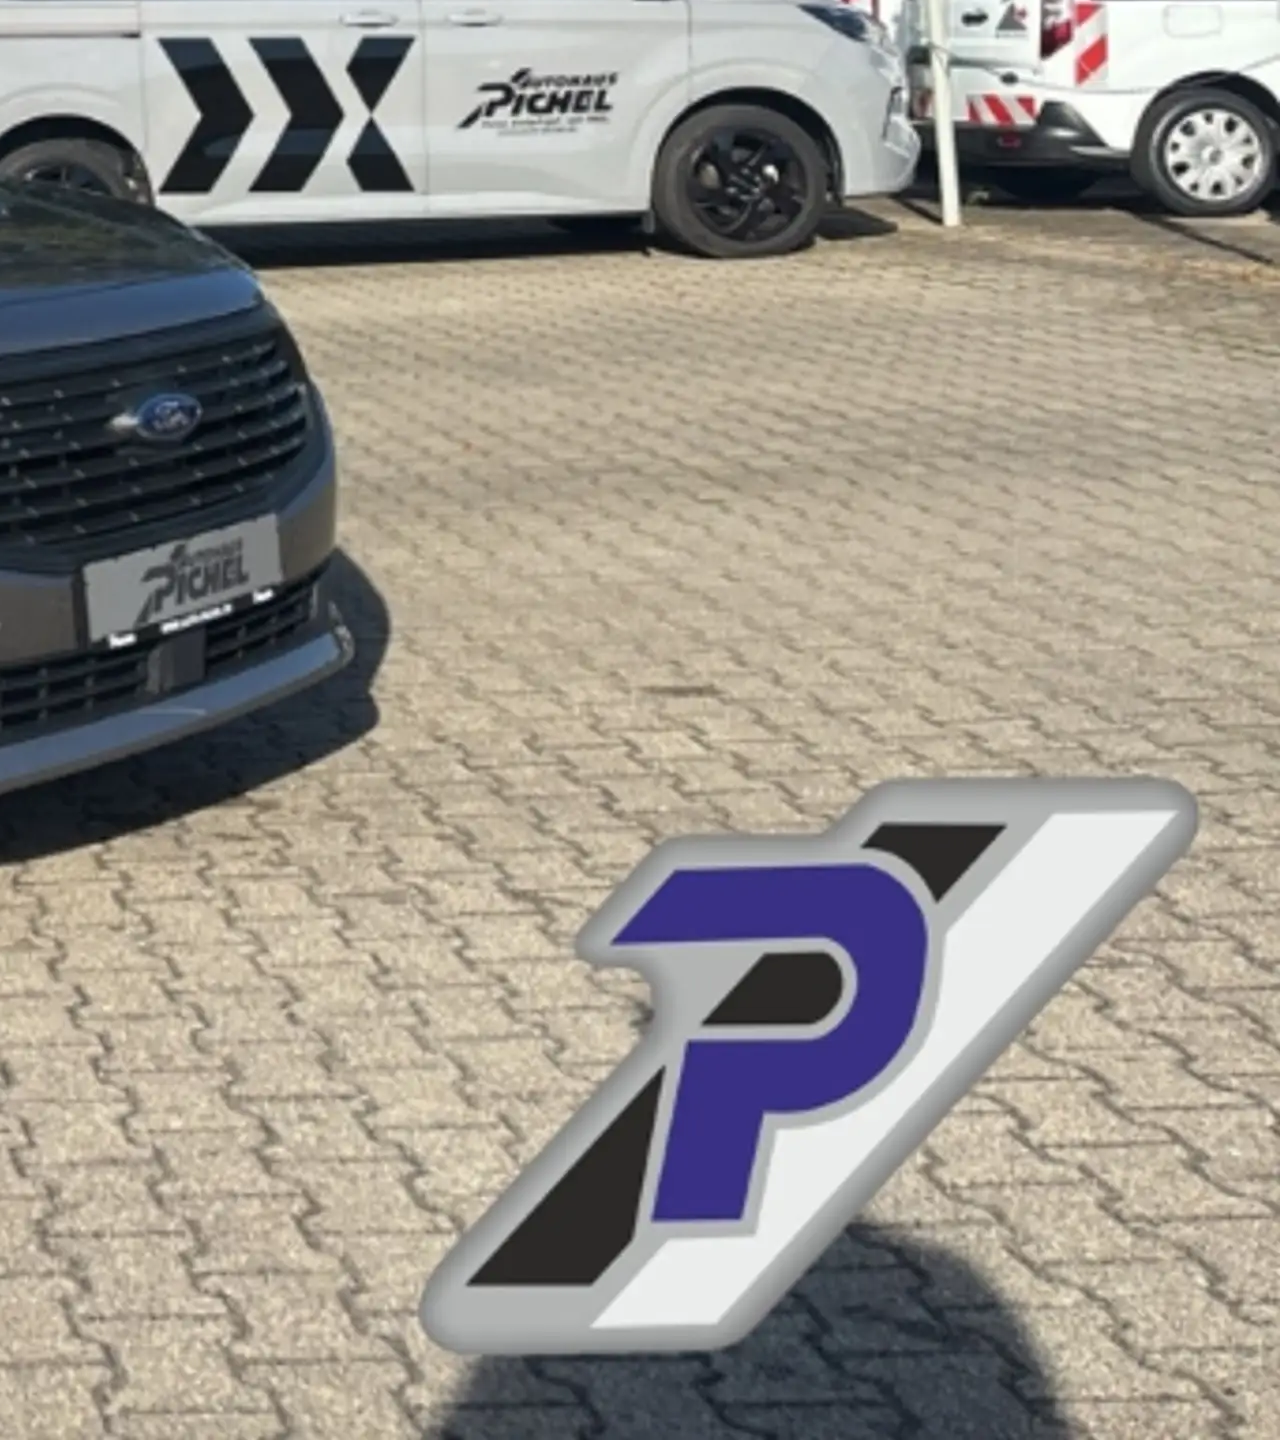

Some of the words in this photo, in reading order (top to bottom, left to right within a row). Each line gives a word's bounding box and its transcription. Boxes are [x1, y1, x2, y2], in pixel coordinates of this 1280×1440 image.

[510, 68, 618, 89] AUTOHAUS
[461, 83, 612, 123] PICHEL
[139, 557, 250, 619] PICHEL
